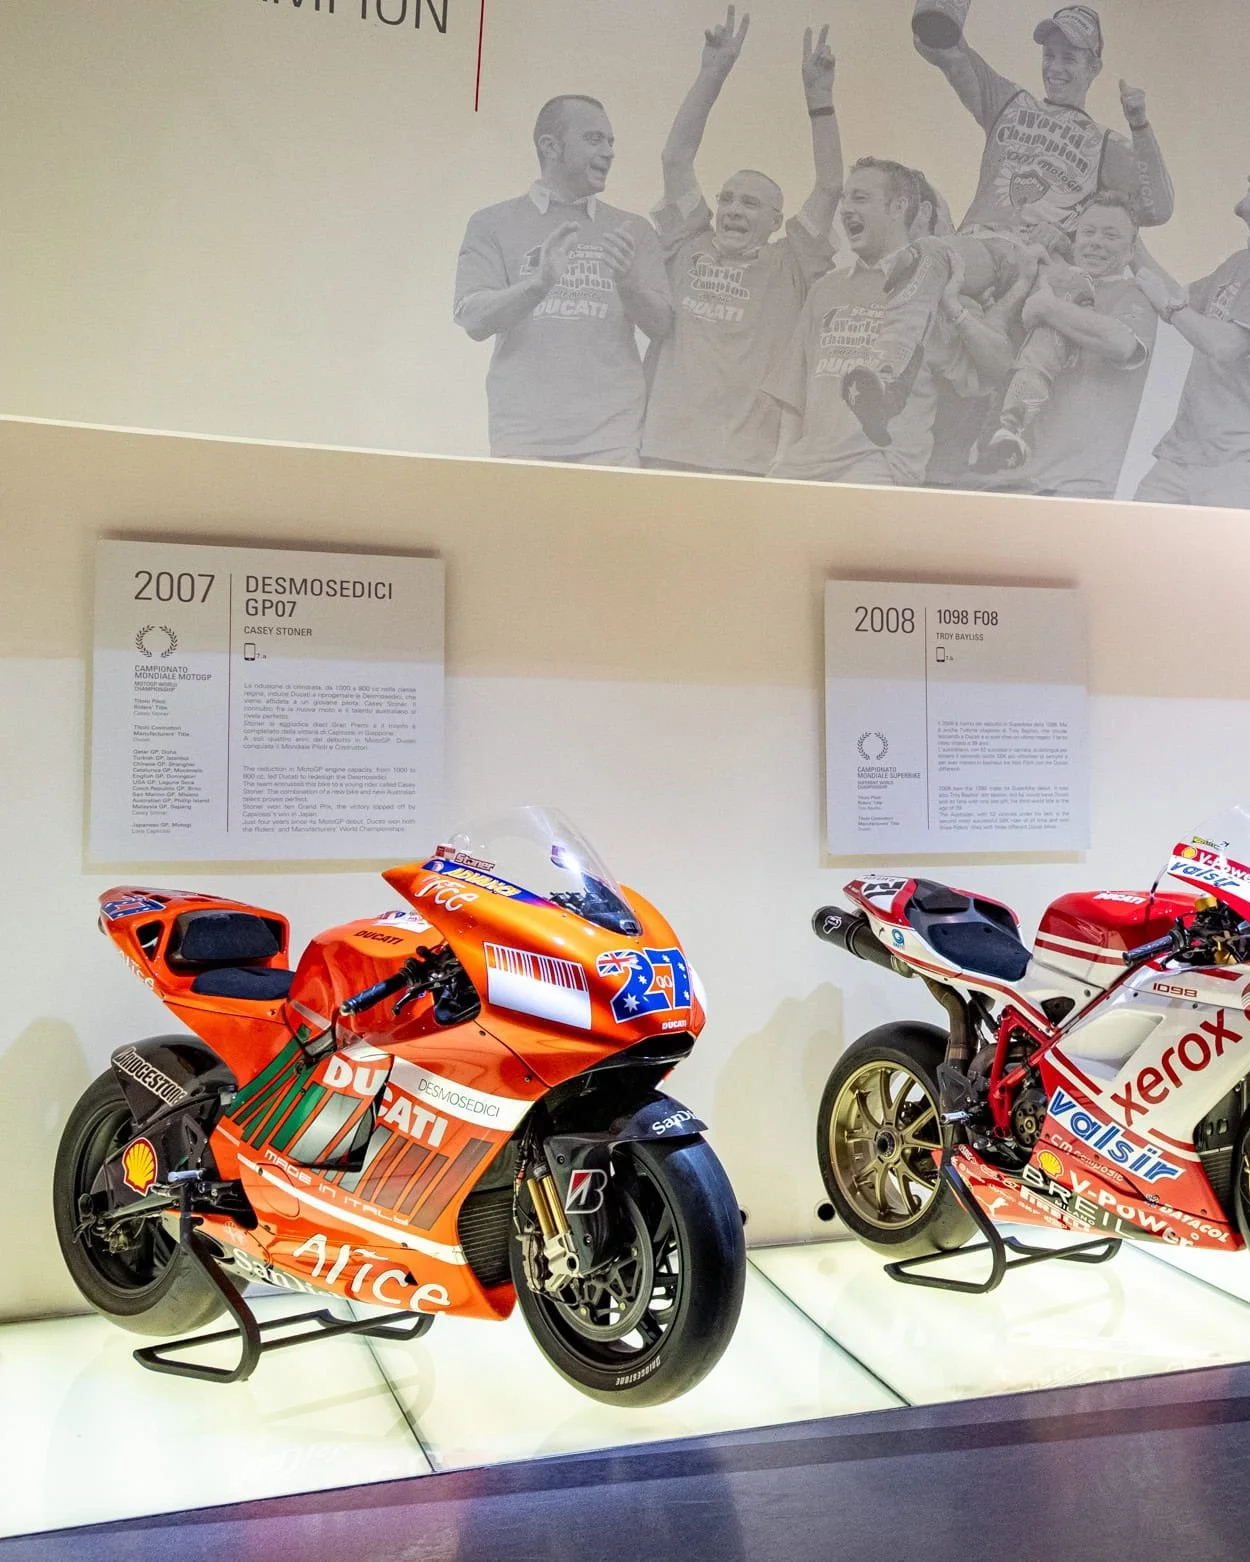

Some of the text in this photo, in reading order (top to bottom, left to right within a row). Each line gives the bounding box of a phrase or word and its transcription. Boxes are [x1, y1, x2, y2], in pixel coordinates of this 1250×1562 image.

[1018, 109, 1087, 150] World
[997, 124, 1090, 175] Champion
[134, 570, 216, 603] 2007
[245, 575, 393, 600] DESMOSEDICI
[244, 599, 297, 618] GP07
[855, 606, 915, 633] 2008
[937, 608, 999, 626] 1098 F08
[243, 626, 312, 637] CASEY STONER
[936, 632, 984, 641] TROY BAYLISS
[134, 664, 188, 674] CAMPIONATO
[134, 672, 212, 681] MONDIALE MOTOGP
[1169, 861, 1241, 888] valsir
[1093, 891, 1148, 905] DUCATI
[353, 930, 405, 945] DUCATI
[596, 947, 692, 1024] 27
[1152, 982, 1198, 998] 1098
[115, 1047, 187, 1107] BRIDGESTONE
[1110, 1008, 1244, 1127] xerox
[323, 1055, 448, 1148] DUCATI
[418, 1078, 501, 1118] DESMOSEDICI
[264, 1148, 311, 1185] MADE
[344, 1195, 410, 1225] ITALY
[1023, 1164, 1136, 1239] BREIL
[1055, 1198, 1096, 1226] MILANO
[1070, 1170, 1194, 1247] V-Power
[1160, 1203, 1230, 1243] DATACOL
[293, 1233, 451, 1315] Alice
